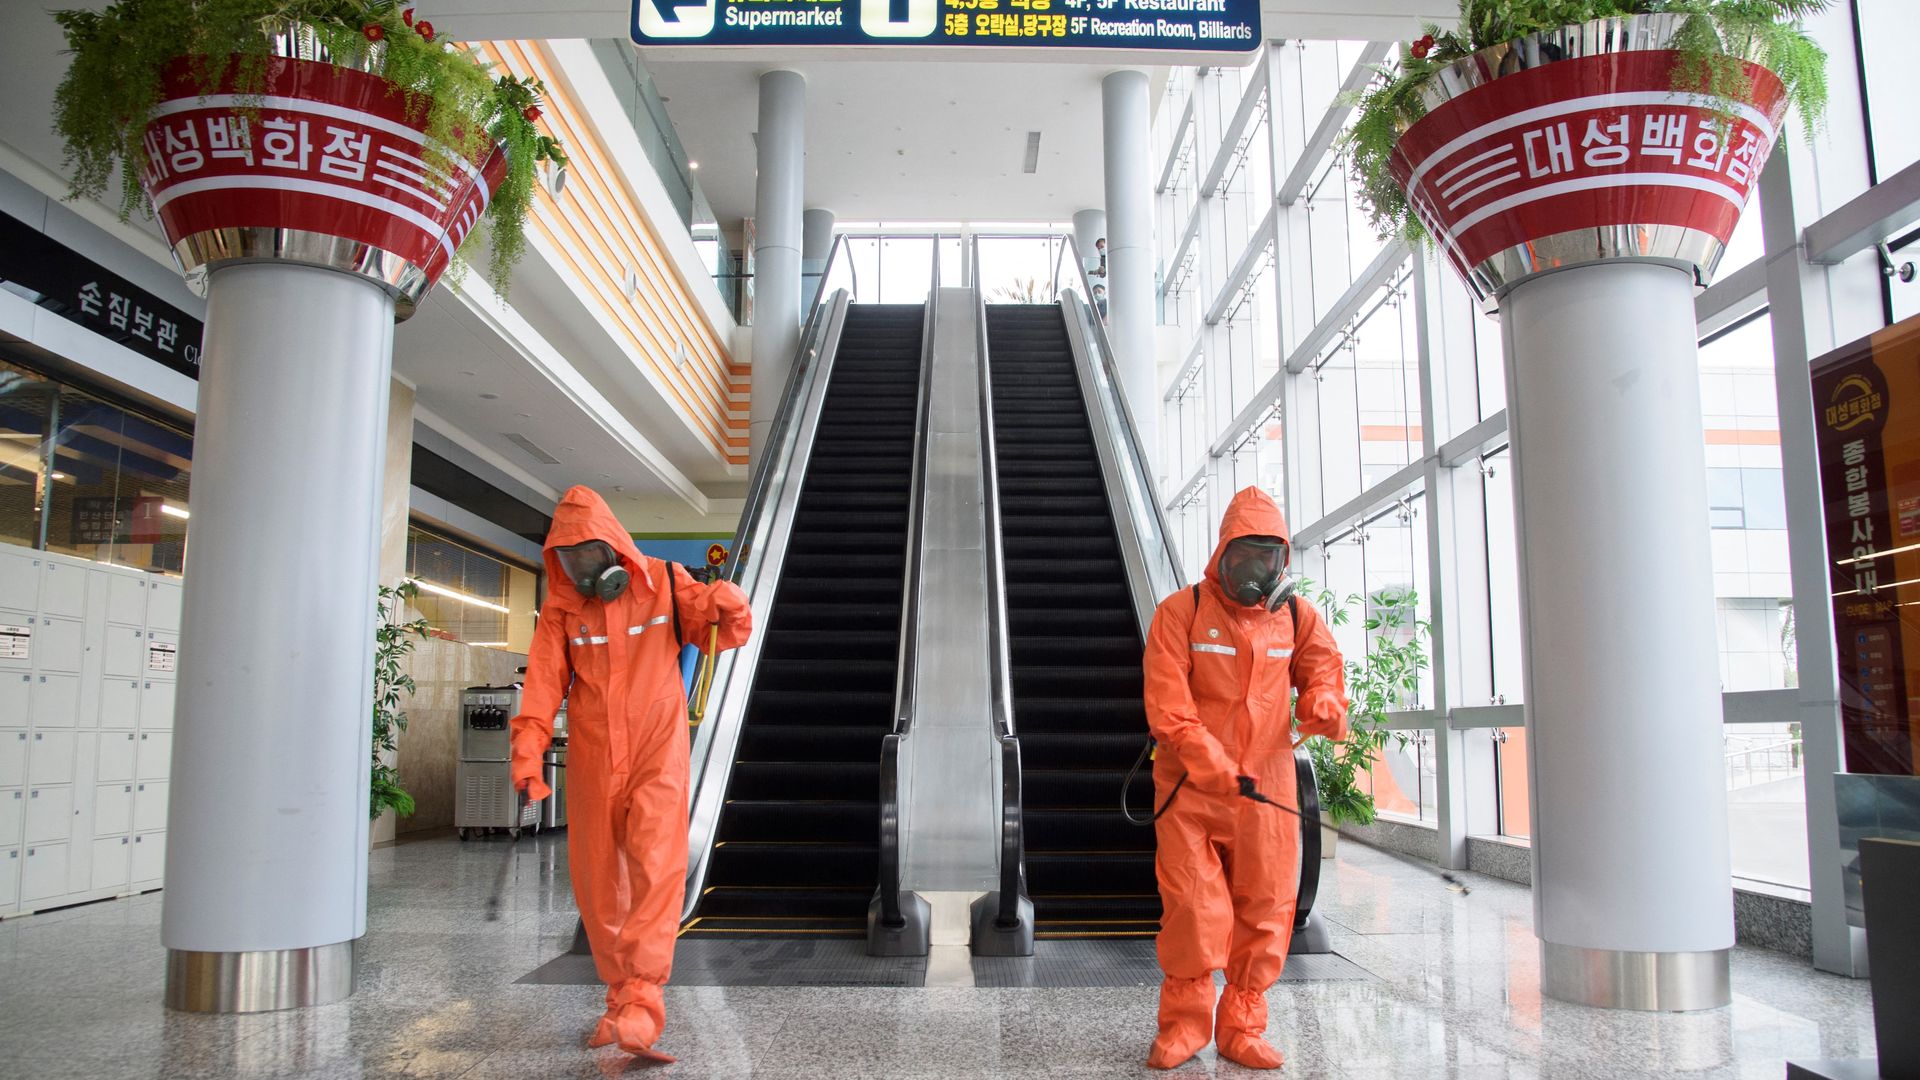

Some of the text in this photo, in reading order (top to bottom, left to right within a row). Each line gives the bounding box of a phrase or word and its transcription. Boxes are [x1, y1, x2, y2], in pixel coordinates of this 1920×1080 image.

[725, 6, 843, 30] Supermarket
[945, 13, 1252, 40] 5층 오락실,당구장 5F Recreation Room, Billiards
[1522, 114, 1761, 187] 대성백화점
[78, 281, 179, 354] 손짐보관
[1826, 392, 1881, 426] 대성백화점
